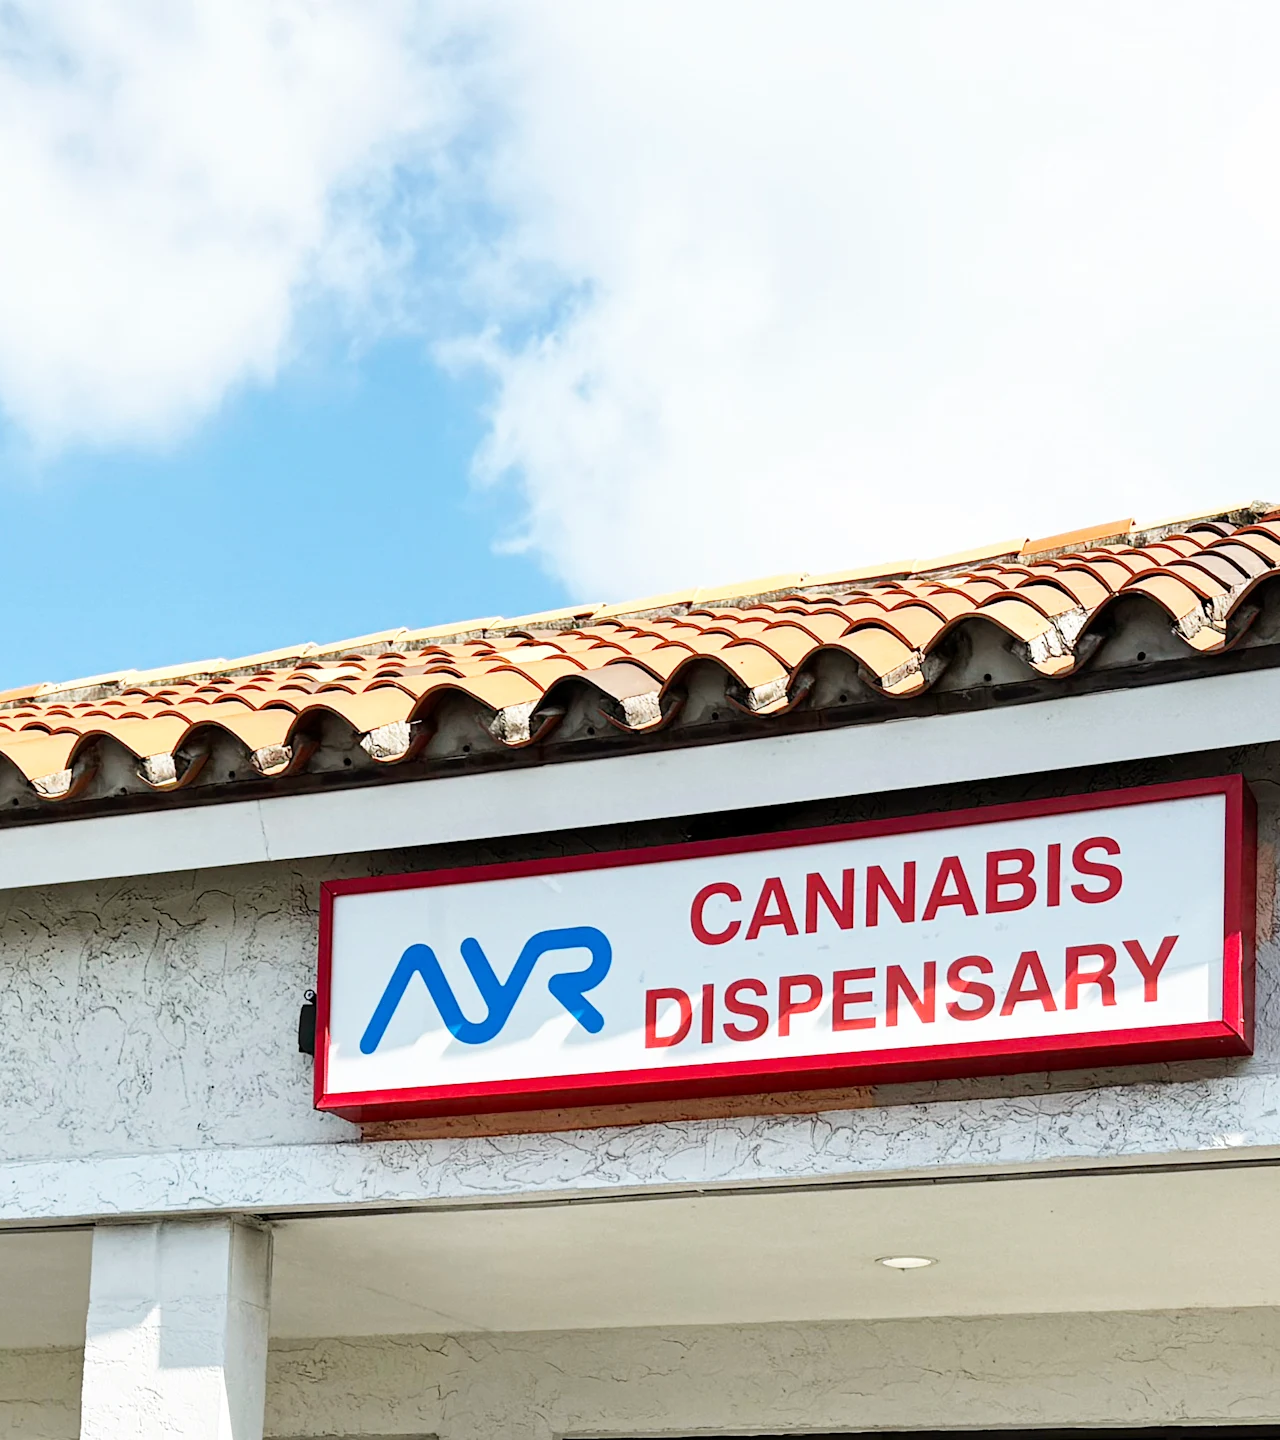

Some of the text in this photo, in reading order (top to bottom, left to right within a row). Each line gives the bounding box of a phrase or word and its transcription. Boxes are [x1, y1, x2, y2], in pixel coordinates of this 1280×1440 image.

[690, 836, 1122, 946] CANNABIS
[359, 925, 613, 1055] AYR
[643, 935, 1179, 1049] DISPENSARY
